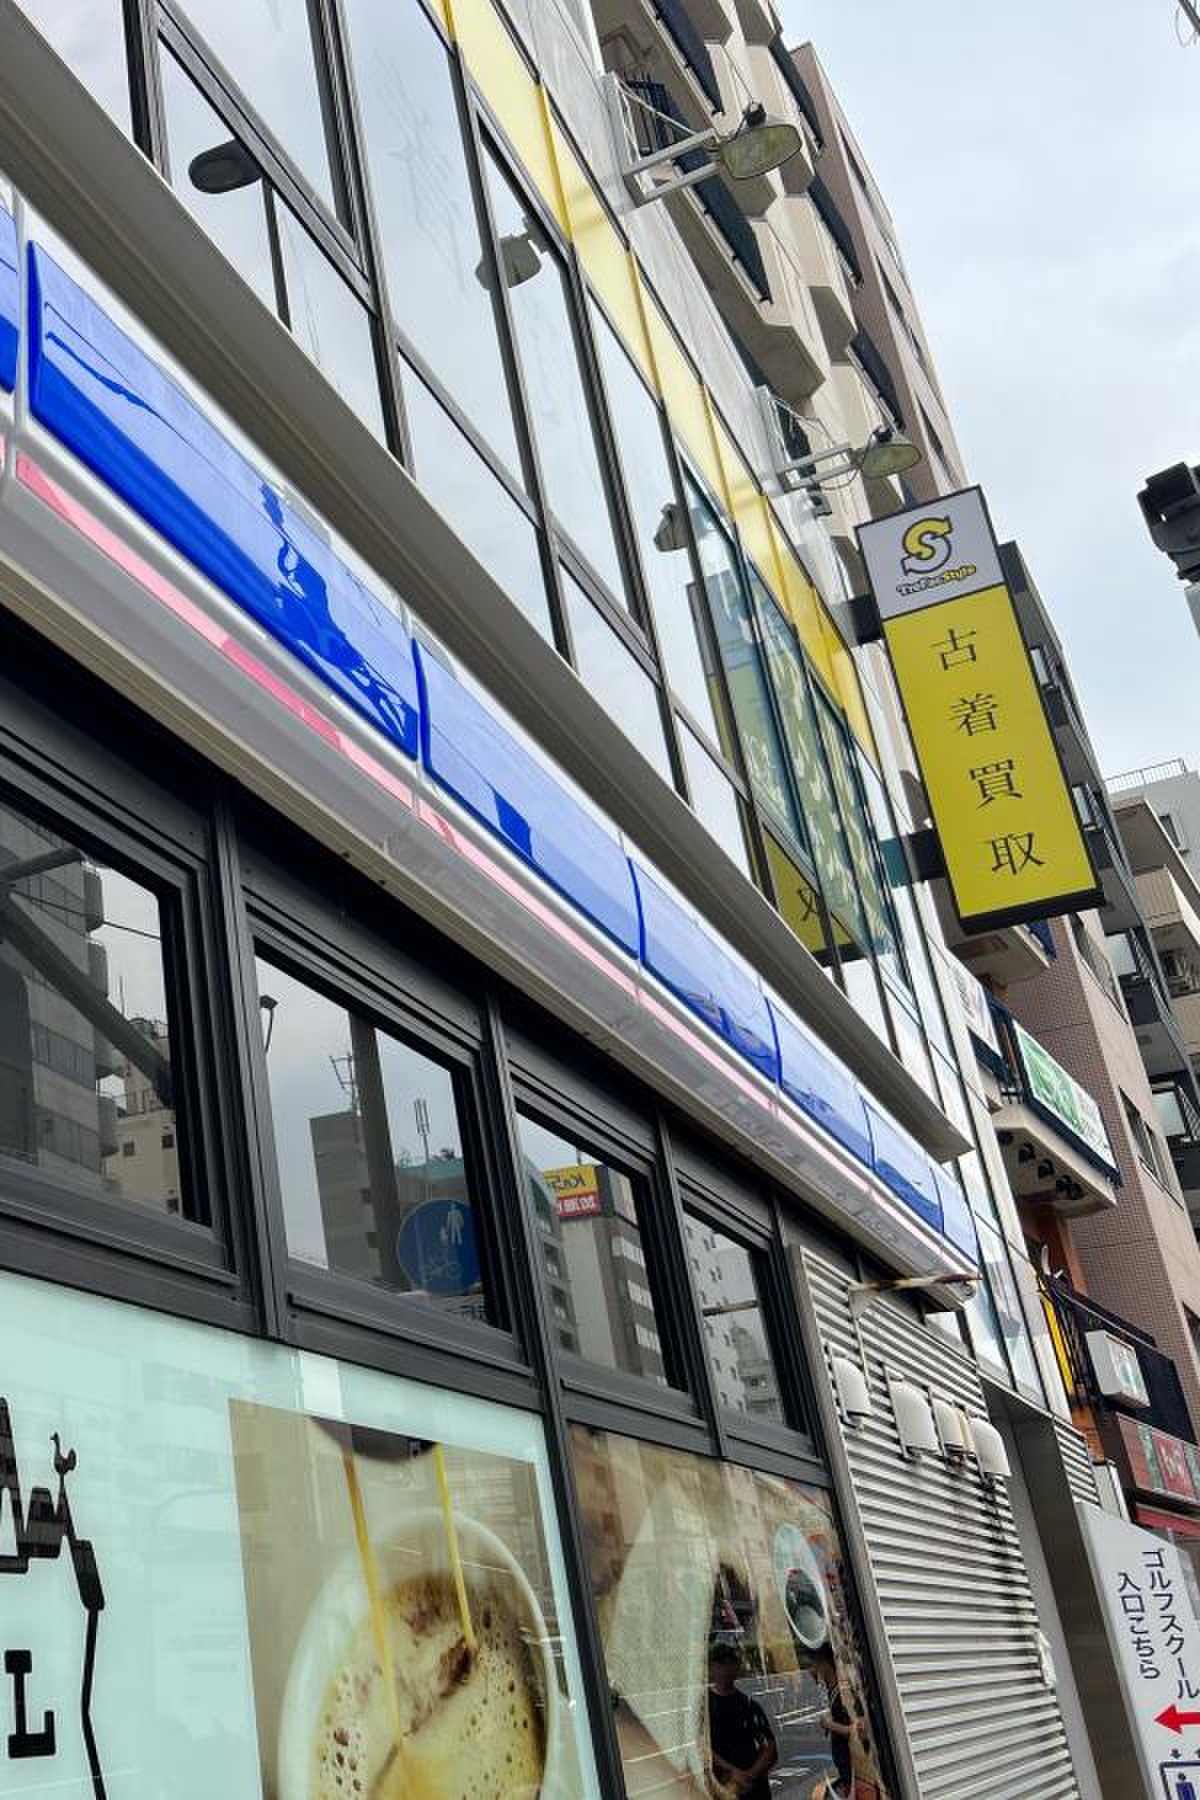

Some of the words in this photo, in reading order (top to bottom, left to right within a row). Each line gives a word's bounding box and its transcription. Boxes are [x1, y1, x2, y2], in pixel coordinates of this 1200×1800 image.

[931, 627, 1046, 877] 古着買取
[1117, 1572, 1161, 1681] 入口こちら
[1141, 1547, 1200, 1700] ゴルフスクール
